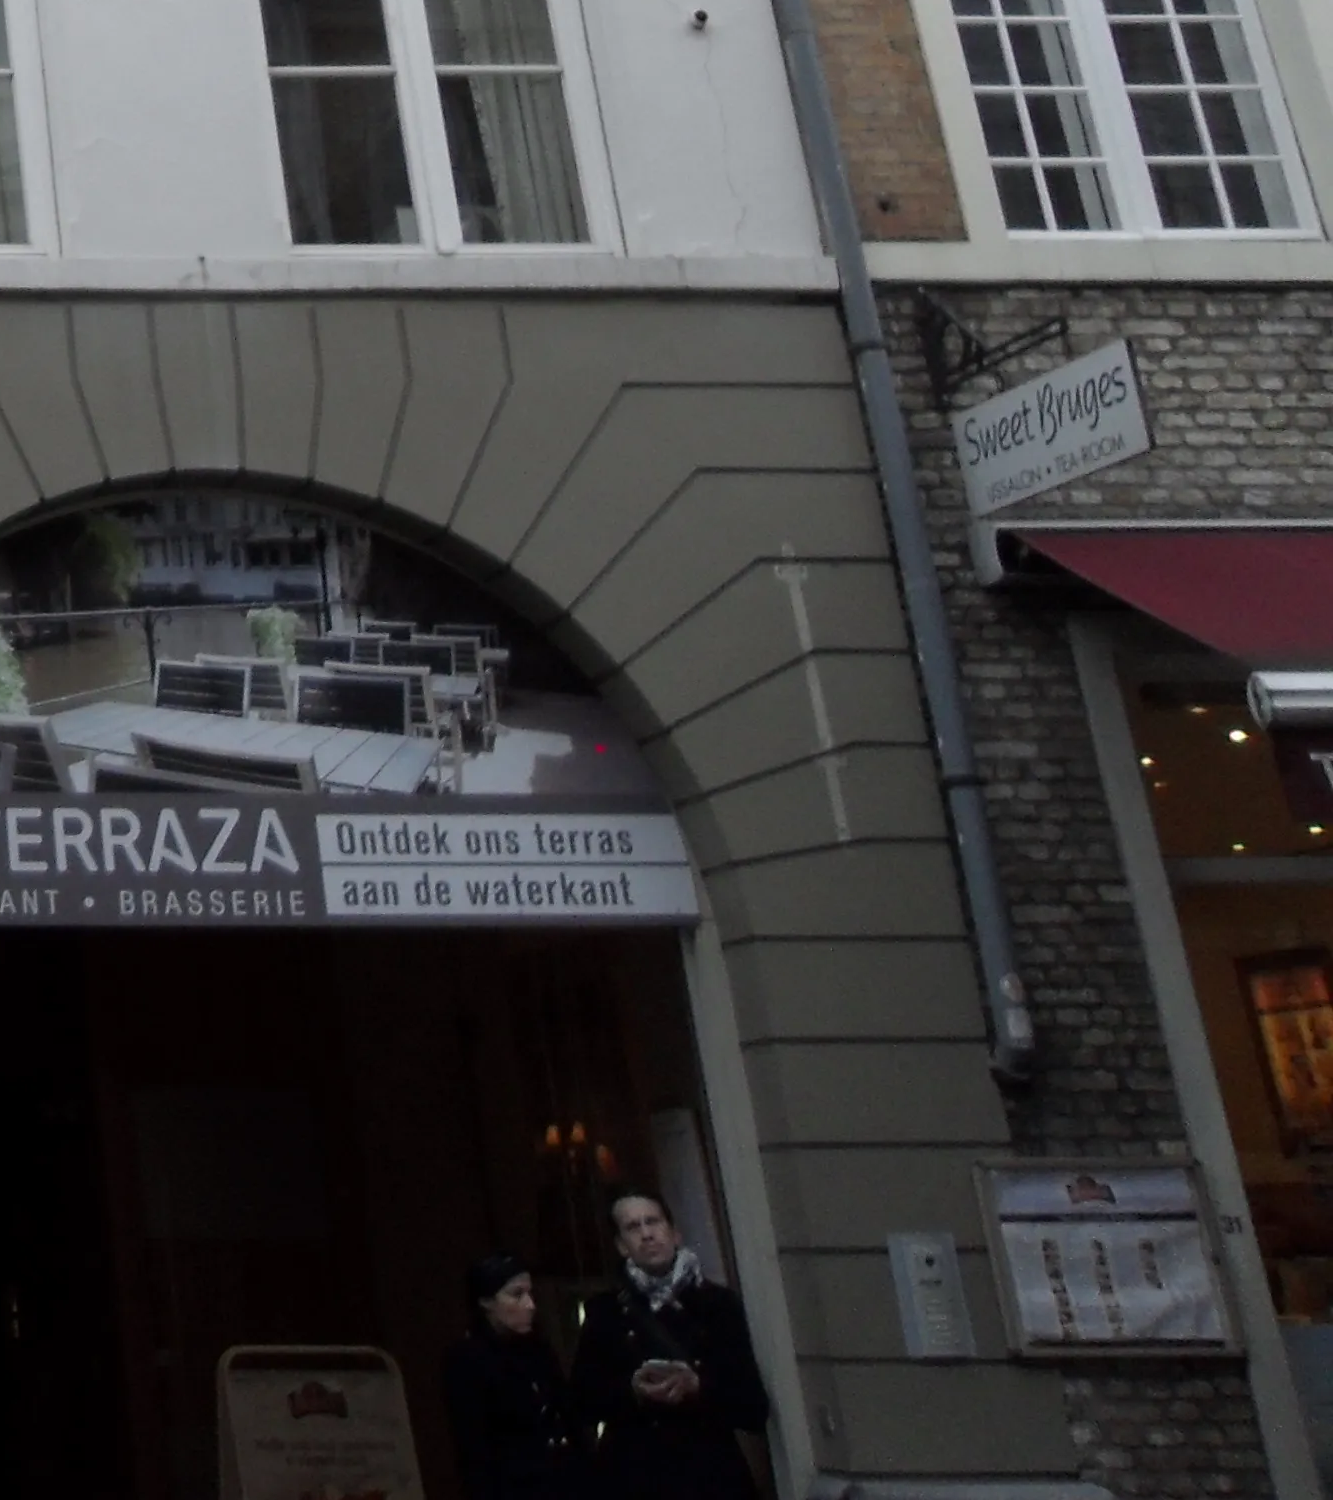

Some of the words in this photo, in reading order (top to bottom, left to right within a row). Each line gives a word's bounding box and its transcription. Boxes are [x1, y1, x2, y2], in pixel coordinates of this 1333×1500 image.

[964, 400, 1035, 466] Sweet
[1036, 365, 1127, 446] Bruges
[335, 820, 451, 857] Ontdek
[464, 827, 521, 856] ons
[534, 821, 635, 856] terras
[118, 889, 307, 918] BRASSERIE
[341, 880, 399, 907] aan
[413, 871, 452, 907] de
[465, 871, 635, 907] waterkant
